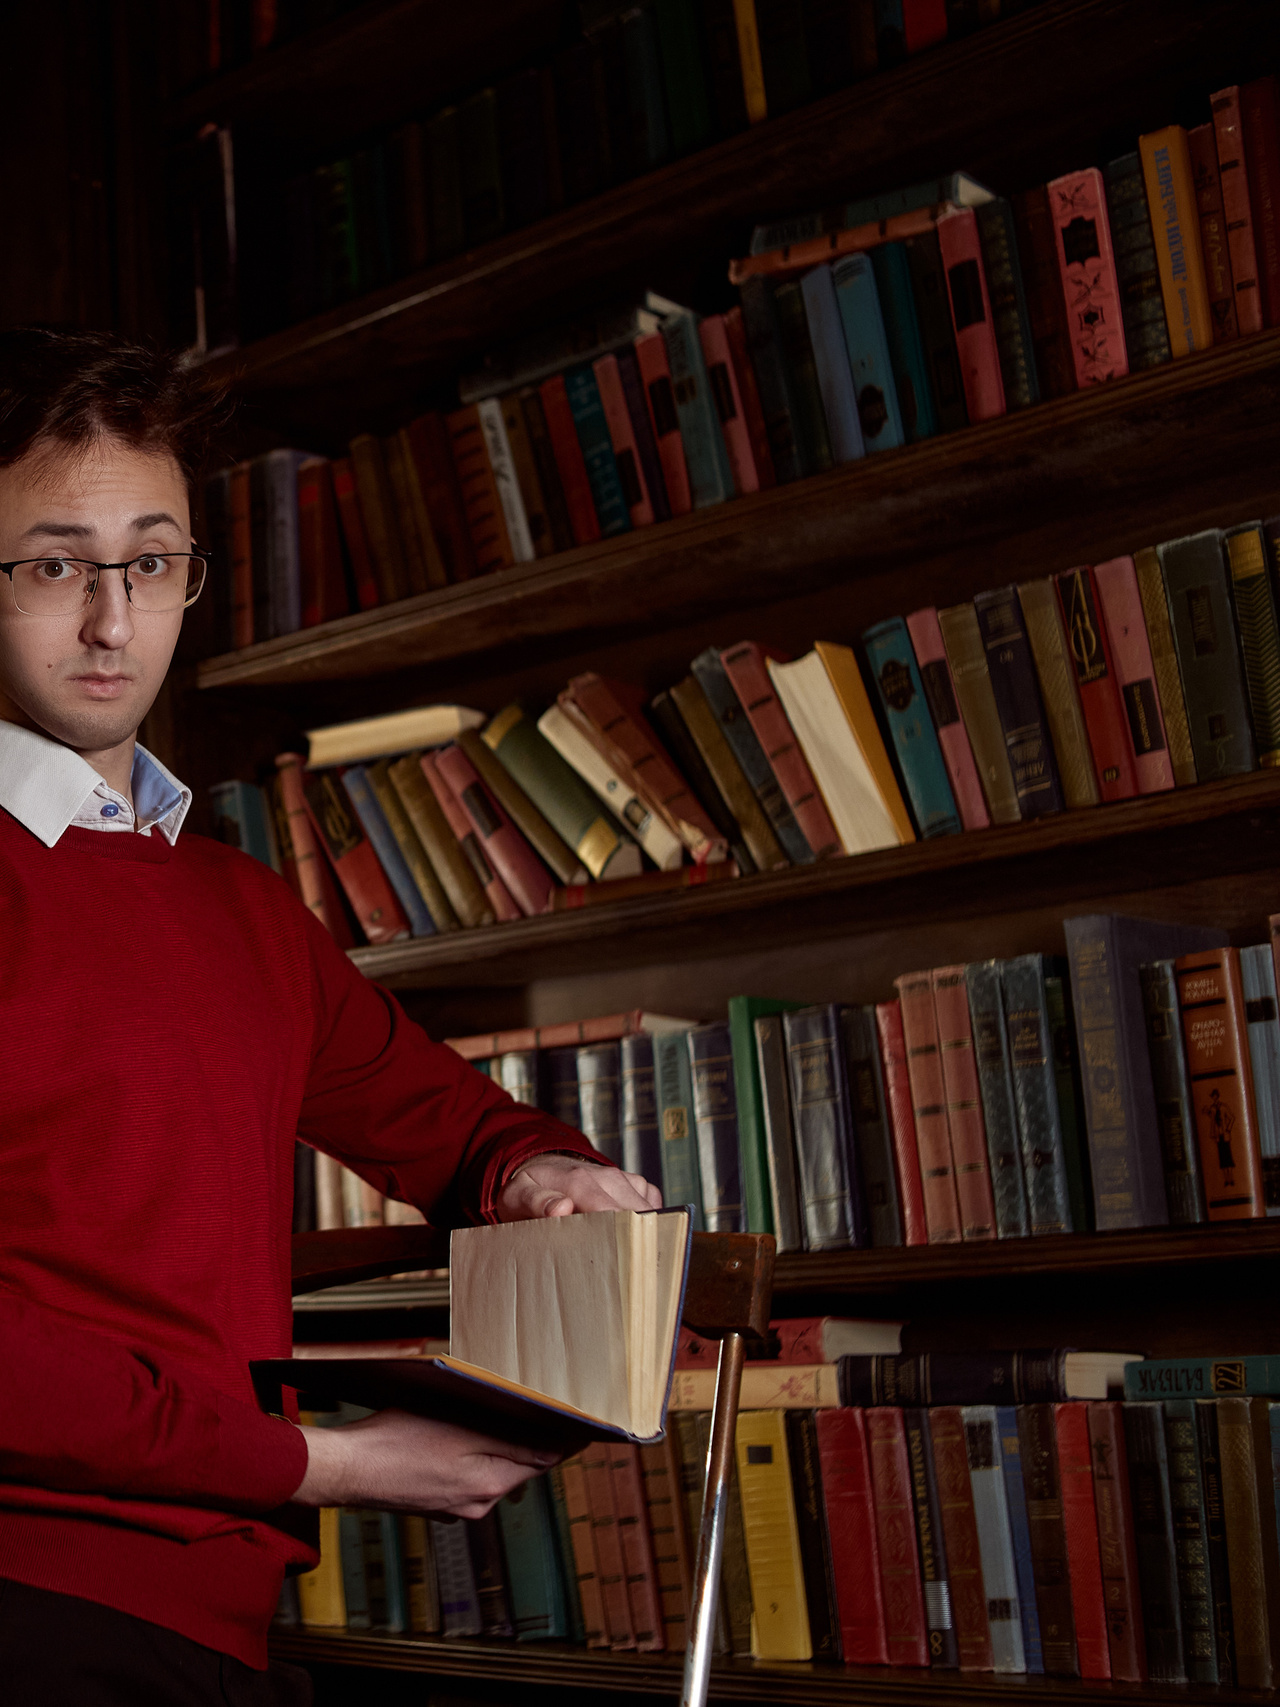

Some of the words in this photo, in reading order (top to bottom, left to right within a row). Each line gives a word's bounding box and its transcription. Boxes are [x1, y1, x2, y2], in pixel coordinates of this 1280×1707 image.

[1184, 986, 1219, 999] РОЛЛАН
[1191, 1018, 1224, 1030] ОЧАРО-
[1190, 1027, 1225, 1040] ВАННАЯ
[1196, 1037, 1222, 1049] ДУША
[1138, 1368, 1202, 1392] БАЛЬЗАК
[1215, 1363, 1241, 1388] 22
[1110, 1586, 1120, 1601] 2
[928, 1630, 943, 1656] 8
